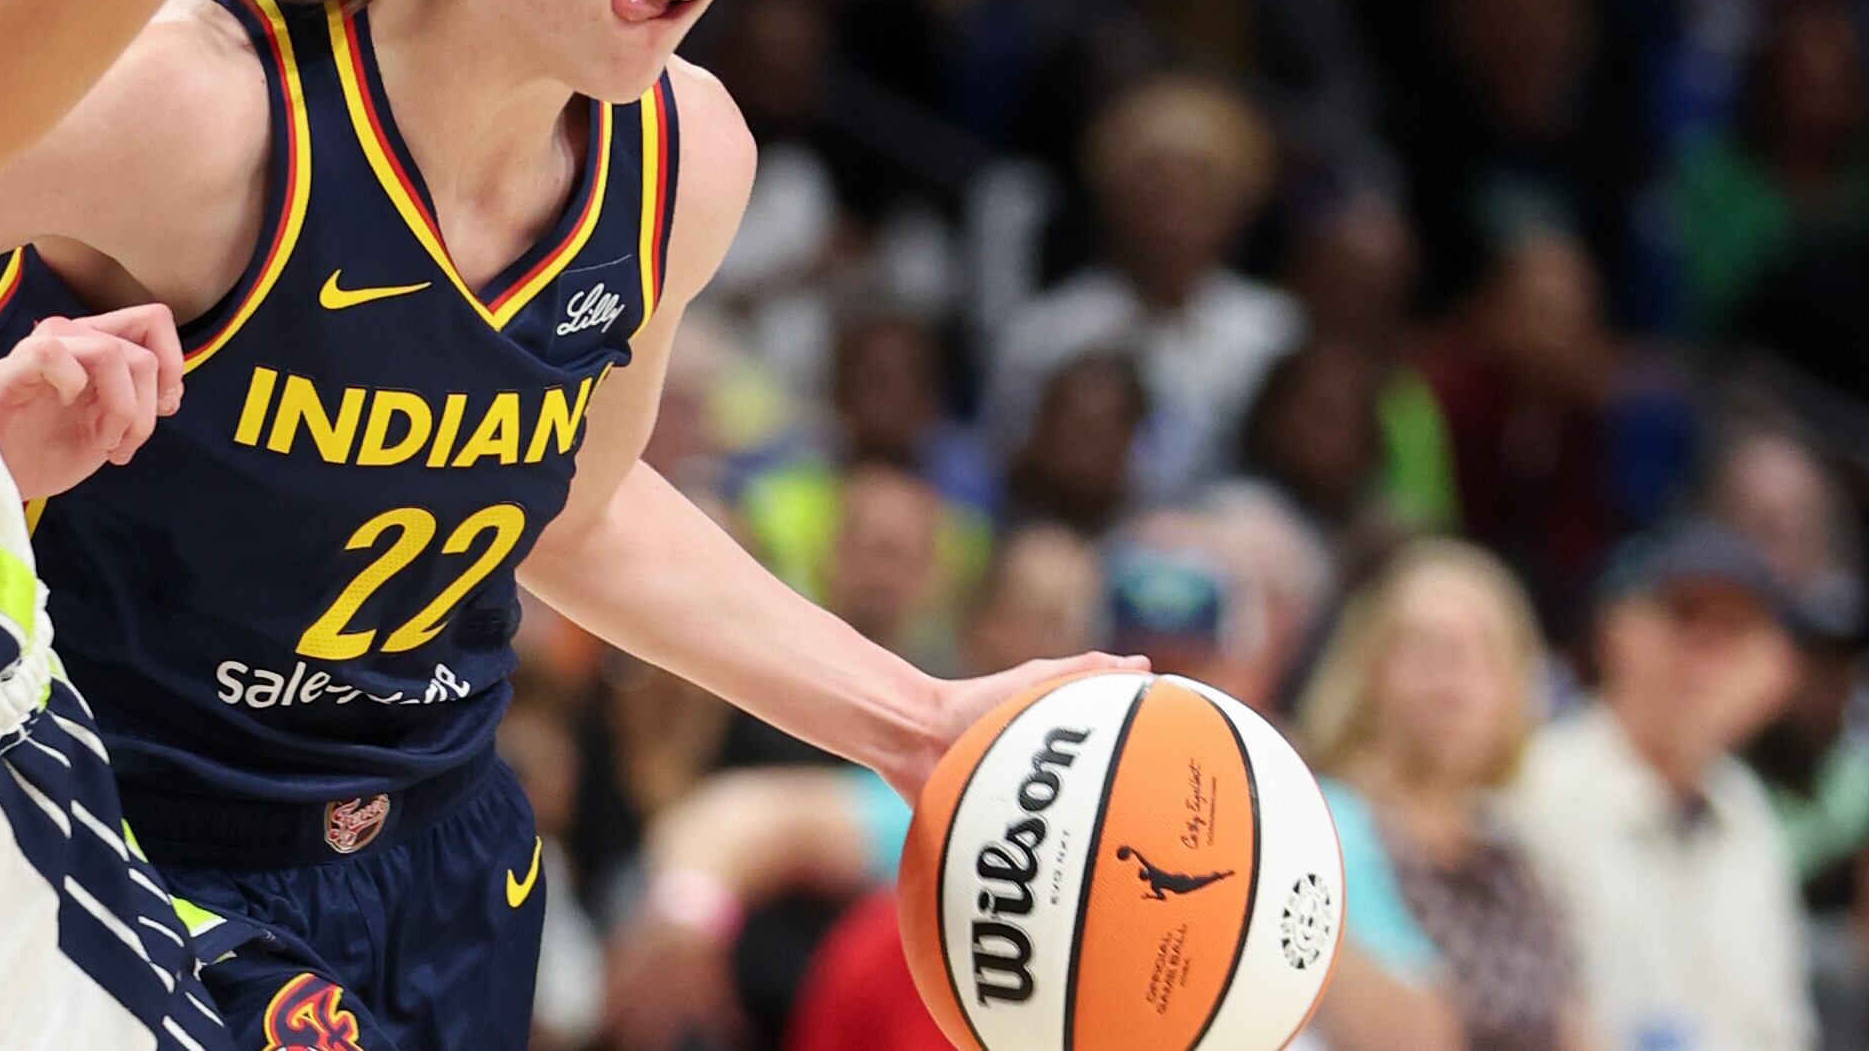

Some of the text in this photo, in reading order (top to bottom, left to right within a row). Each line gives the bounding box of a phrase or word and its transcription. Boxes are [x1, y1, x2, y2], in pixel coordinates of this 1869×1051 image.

[556, 282, 626, 336] Lilly
[233, 365, 613, 469] INDIAN
[295, 504, 527, 661] 22
[971, 727, 1094, 1007] Wilson
